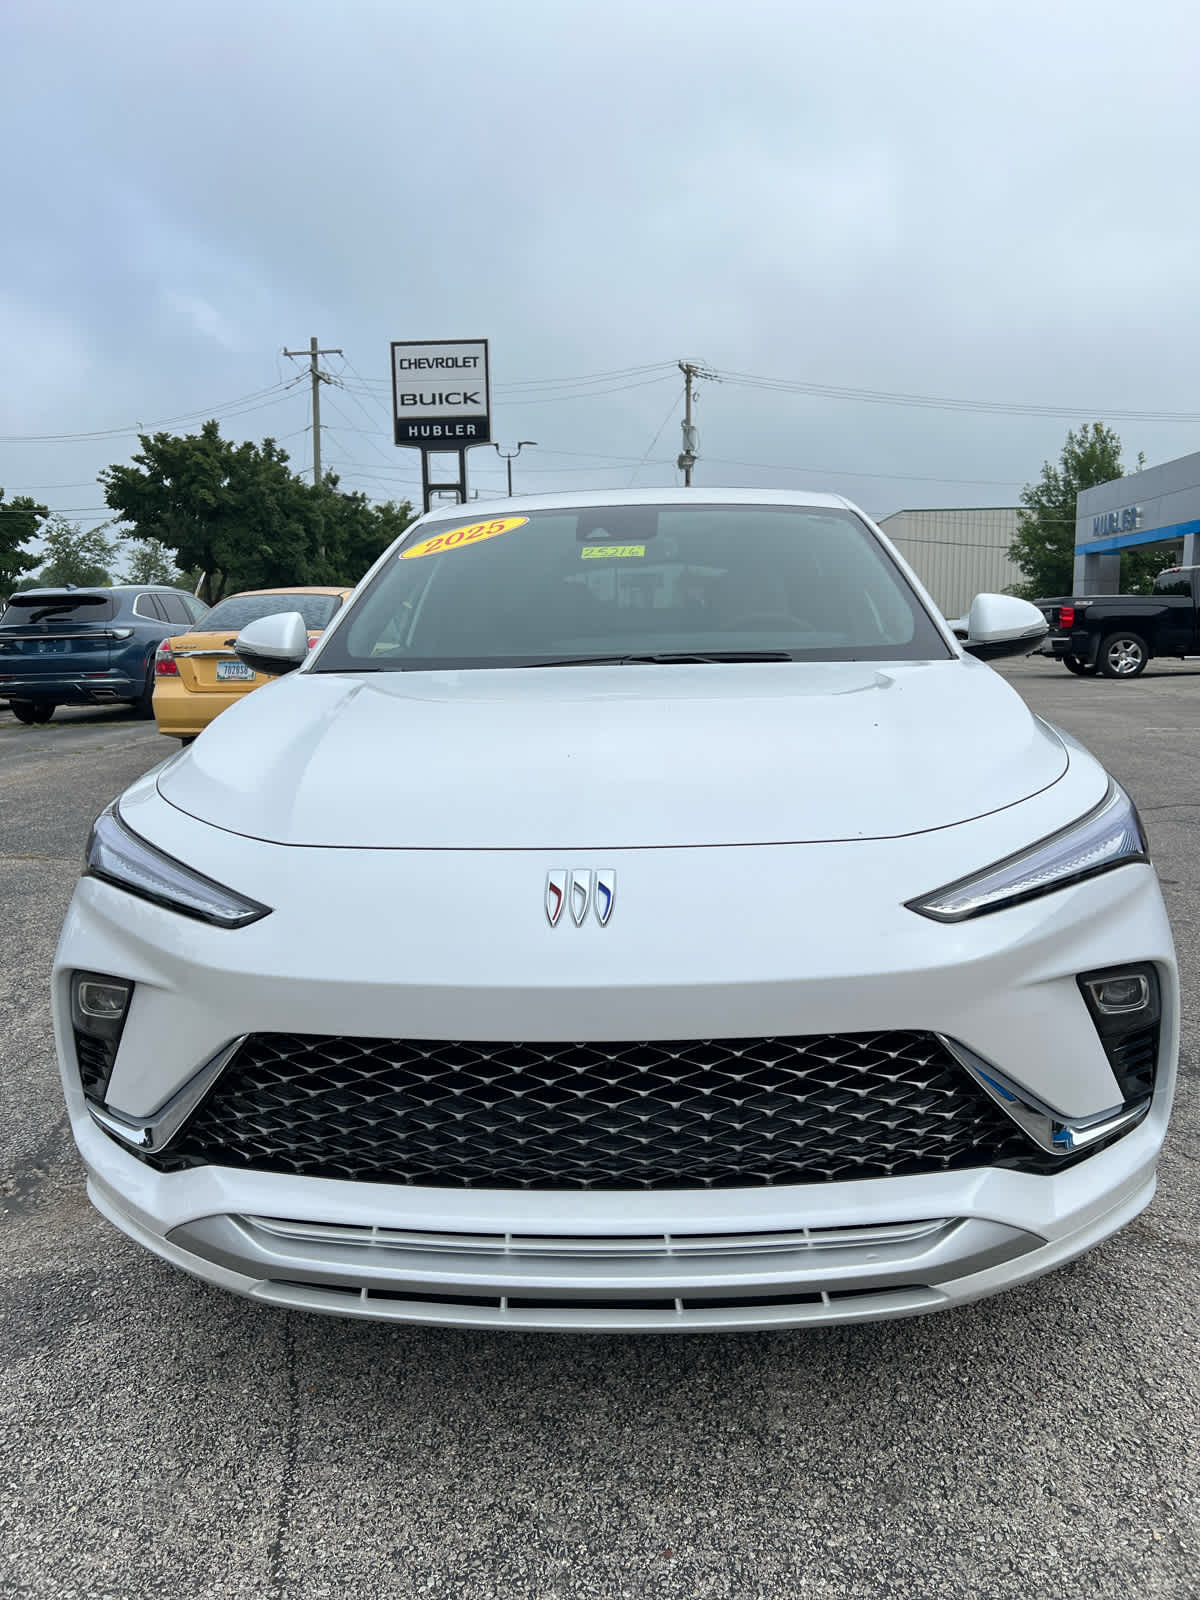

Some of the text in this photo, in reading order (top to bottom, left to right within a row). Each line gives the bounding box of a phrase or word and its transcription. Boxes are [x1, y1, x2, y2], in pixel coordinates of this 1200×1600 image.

[399, 356, 480, 370] CHEVROLET
[400, 392, 481, 406] BUICK
[408, 424, 476, 437] HUBLER
[423, 520, 505, 553] 2025
